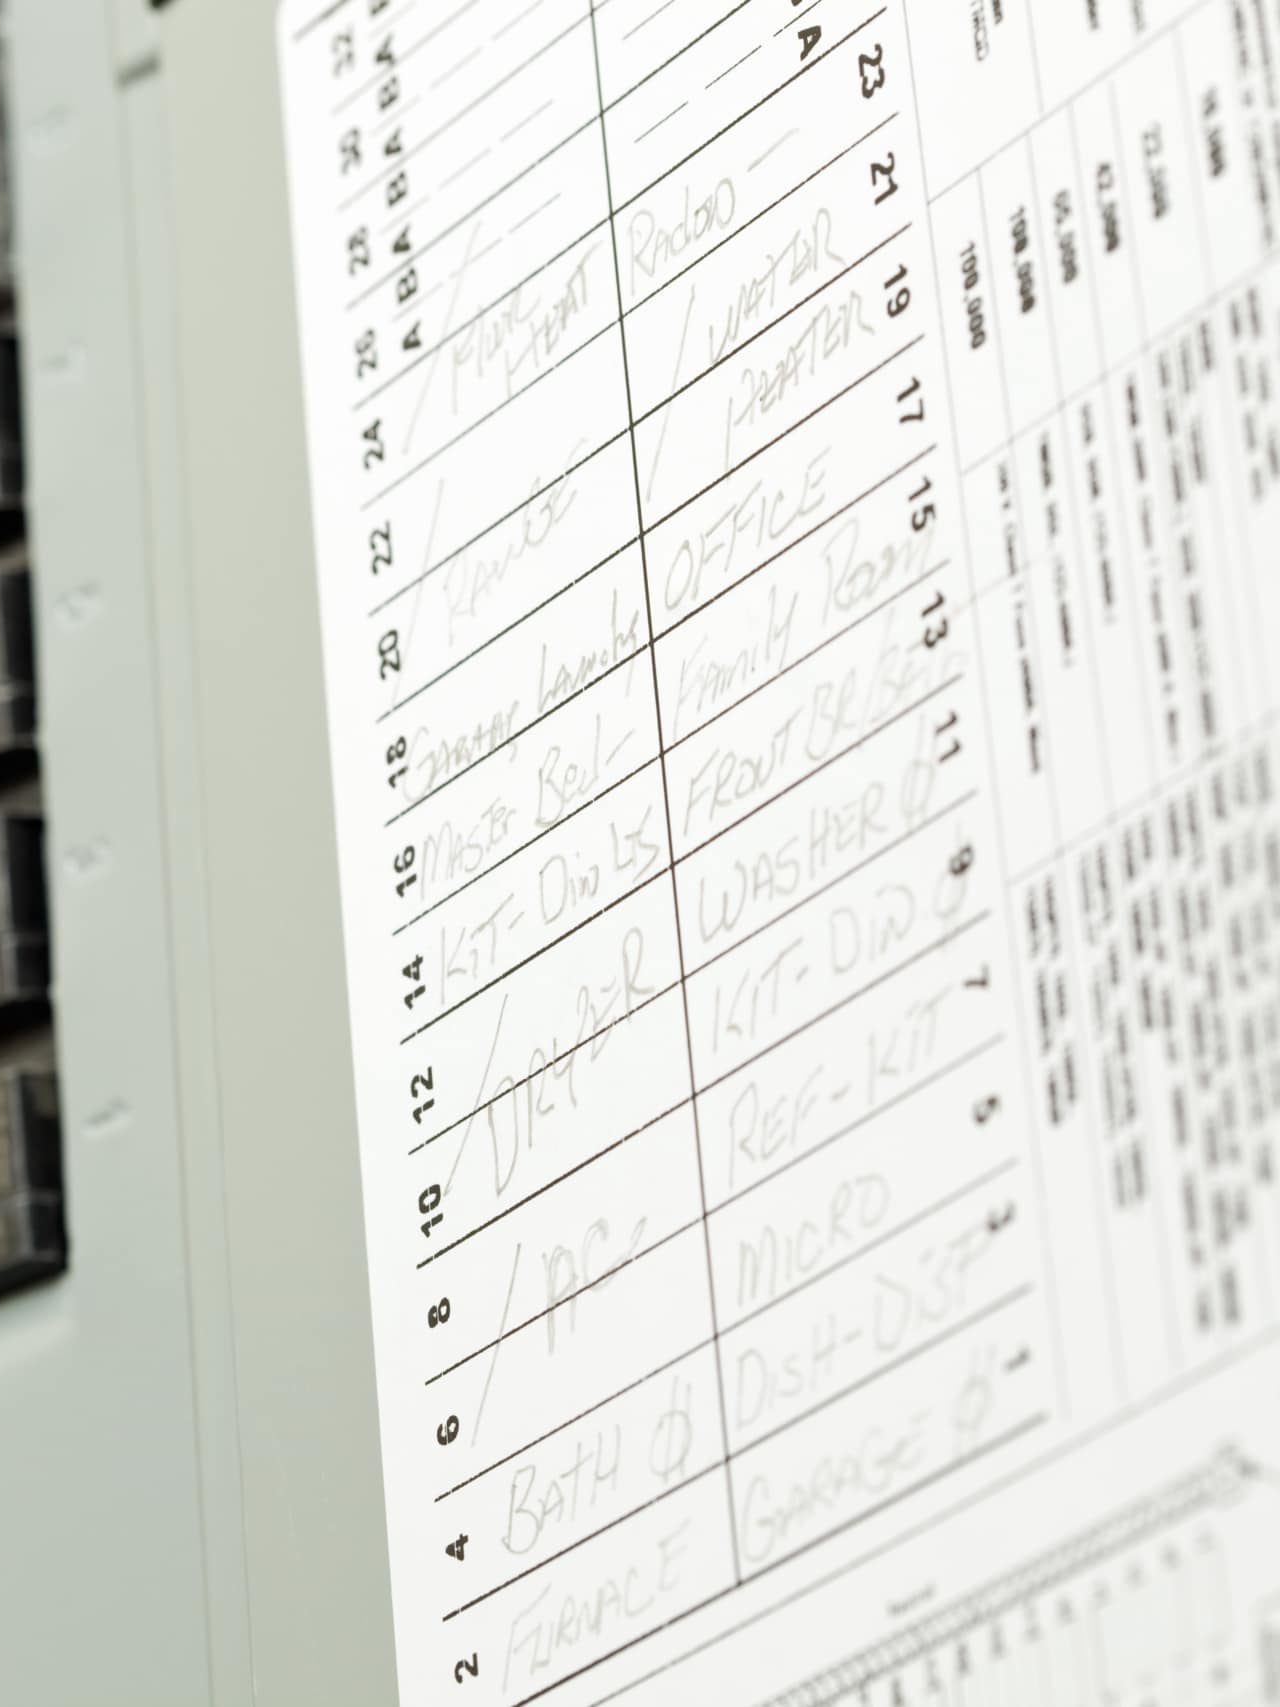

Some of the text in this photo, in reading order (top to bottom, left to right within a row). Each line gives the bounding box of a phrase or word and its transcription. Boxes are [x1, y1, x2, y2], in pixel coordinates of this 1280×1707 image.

[797, 25, 821, 60] A
[858, 44, 885, 98] 23
[870, 152, 898, 205] 21
[392, 224, 411, 254] A
[396, 267, 418, 304] B
[883, 263, 911, 318] 19
[402, 320, 422, 350] A
[896, 377, 925, 424] 17
[362, 418, 385, 470] 24
[665, 446, 832, 610] OFFICE
[908, 475, 937, 532] 15
[370, 520, 393, 574] 22
[922, 590, 949, 649] 13
[378, 629, 401, 680] 20
[386, 736, 408, 788] 18
[935, 710, 962, 764] 11
[393, 845, 417, 897] 16
[699, 782, 888, 943] WASHER
[402, 954, 426, 1009] 14
[410, 1066, 435, 1124] 12
[418, 1183, 444, 1239] 10
[738, 1173, 892, 1308] MICRO
[427, 1297, 451, 1329] 8
[436, 1414, 460, 1446] 6
[501, 1423, 622, 1554] BATH
[445, 1533, 469, 1561] 4
[501, 1517, 693, 1694] FURNACE
[455, 1652, 479, 1684] 2
